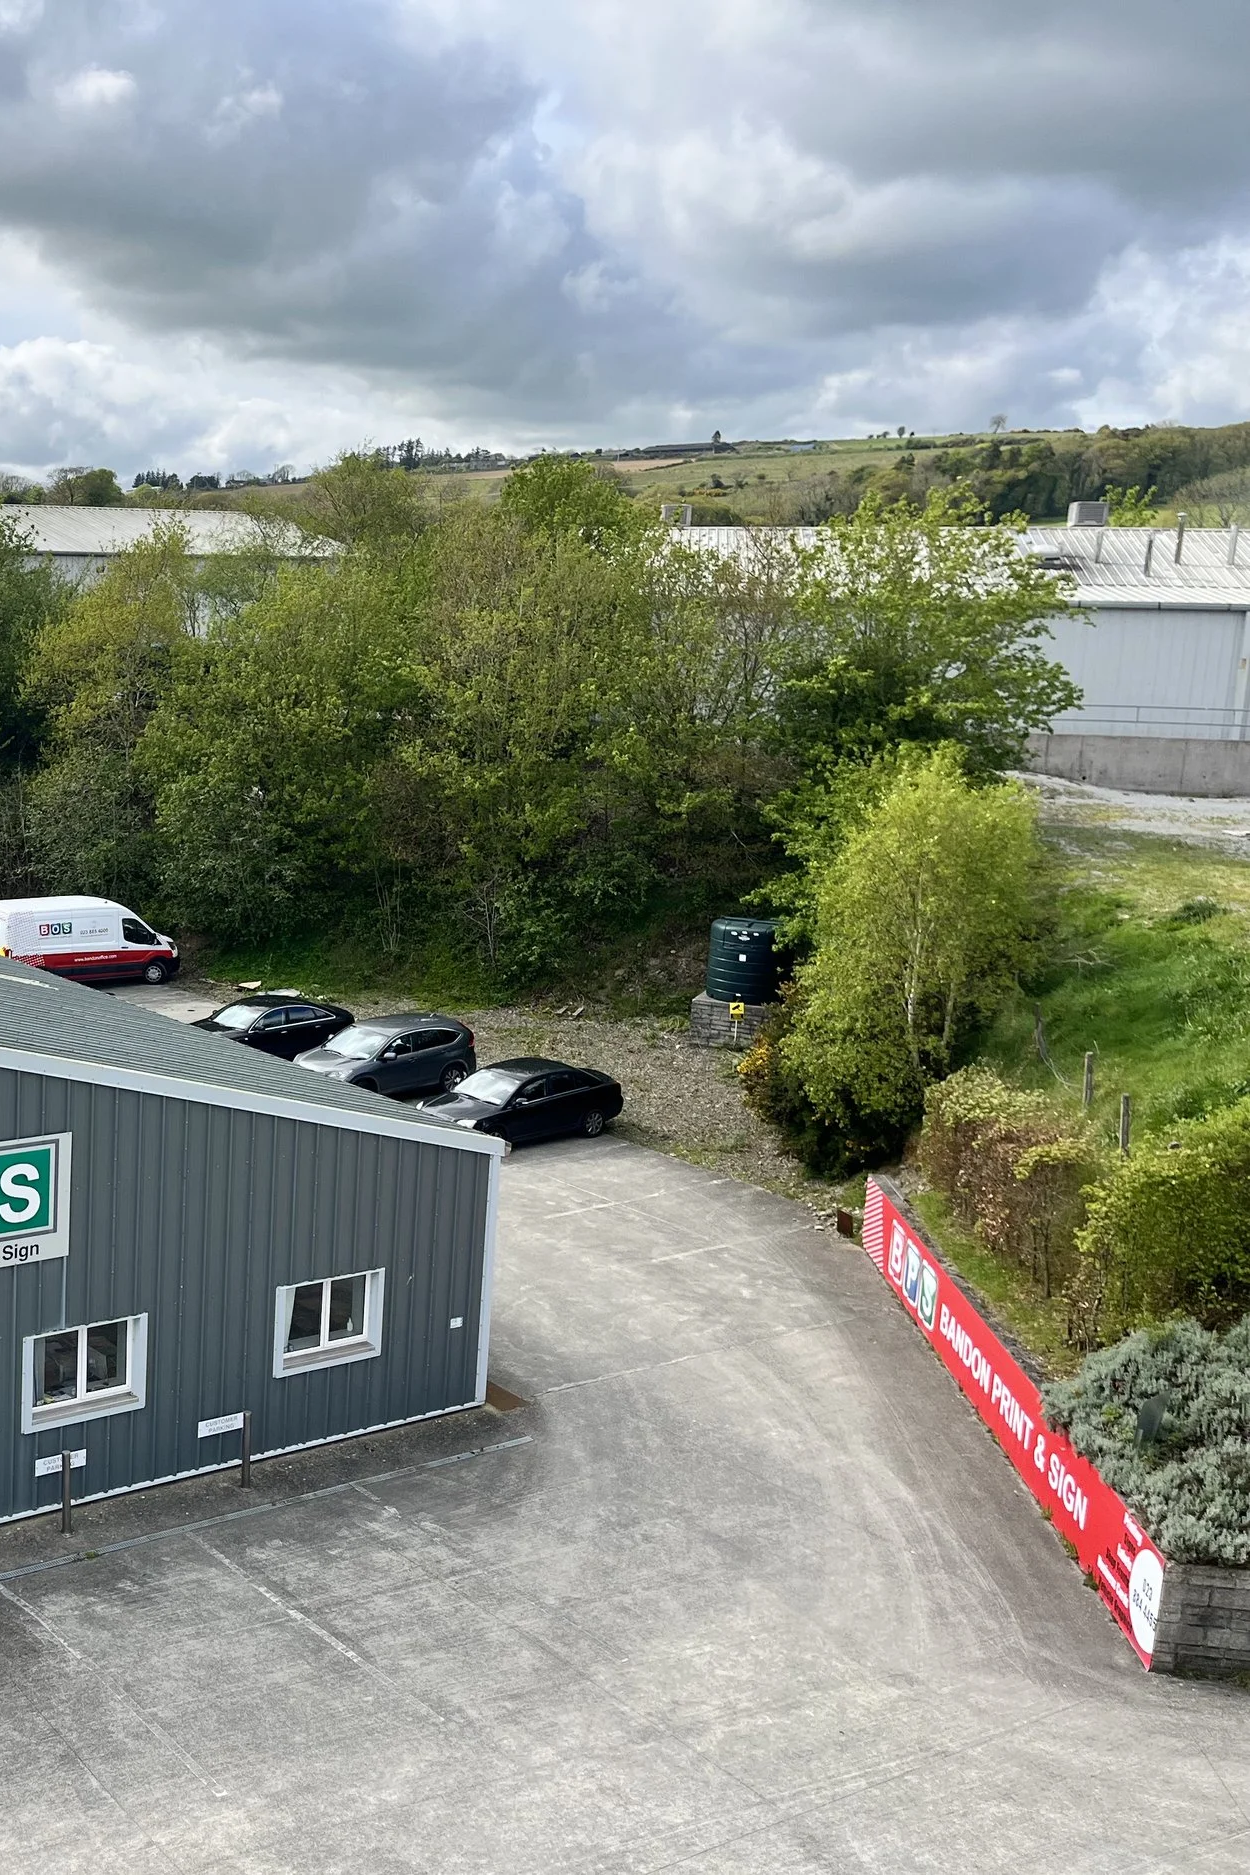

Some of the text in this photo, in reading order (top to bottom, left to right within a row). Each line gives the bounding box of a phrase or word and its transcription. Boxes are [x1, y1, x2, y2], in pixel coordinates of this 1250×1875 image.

[39, 922, 72, 936] BOS
[2, 1243, 40, 1264] Sign
[889, 1226, 938, 1322] BPS
[205, 1416, 238, 1428] CUSTOMER
[939, 1303, 1088, 1531] BANDON PRINT & SIGN
[208, 1423, 235, 1433] PARKING
[43, 1453, 79, 1466] CUSTER
